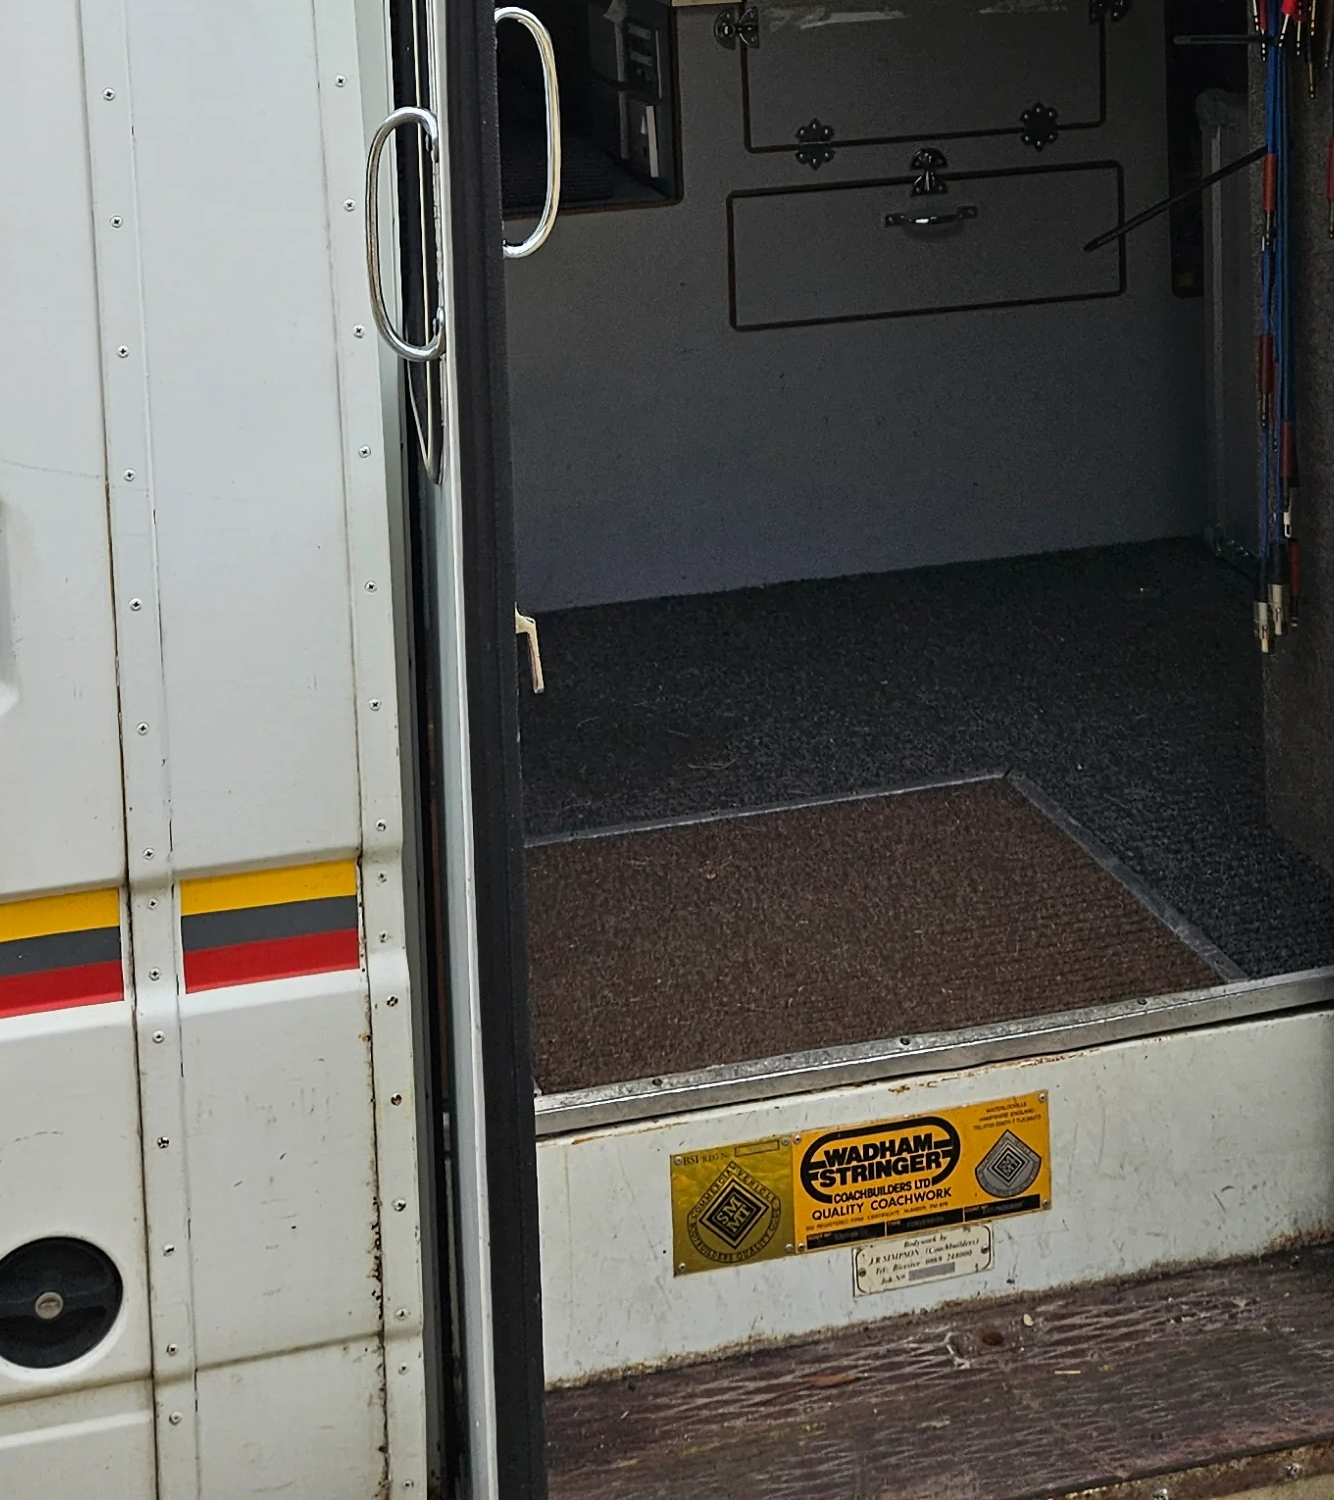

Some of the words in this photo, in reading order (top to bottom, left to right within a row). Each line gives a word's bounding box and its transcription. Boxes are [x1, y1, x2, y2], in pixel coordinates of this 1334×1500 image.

[683, 1154, 699, 1166] BSI
[823, 1132, 933, 1168] WADHAM
[819, 1151, 942, 1188] STRINGER
[690, 1162, 736, 1219] COMMERCIAL
[737, 1169, 779, 1203] VEHICLE
[811, 1202, 864, 1221] QUALITY
[870, 1187, 953, 1211] COACHWORK
[833, 1181, 913, 1204] COACHBUILDERS
[914, 1178, 931, 1190] LTD
[903, 1236, 937, 1248] Bodywork
